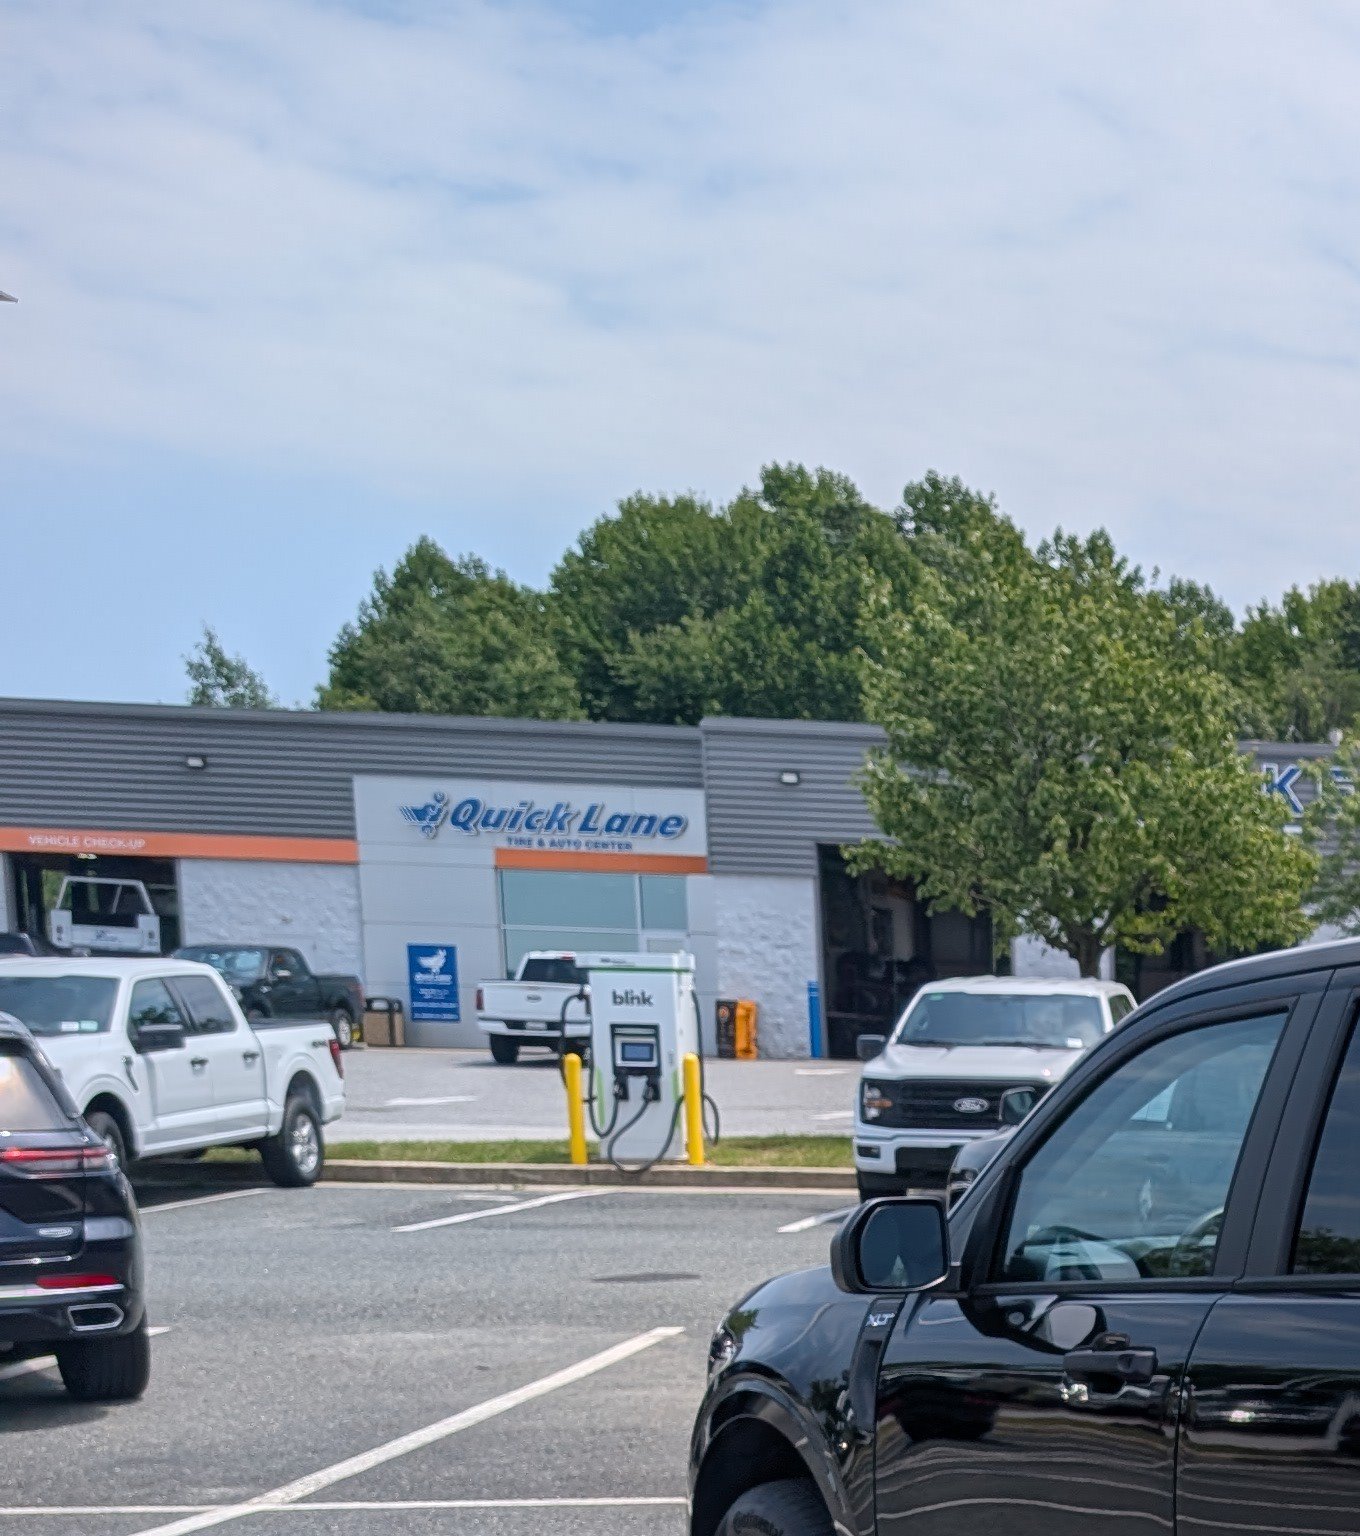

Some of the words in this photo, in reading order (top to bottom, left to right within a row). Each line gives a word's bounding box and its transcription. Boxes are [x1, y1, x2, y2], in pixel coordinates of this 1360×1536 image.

[450, 797, 574, 836] Quick
[577, 800, 688, 838] Lane
[28, 835, 79, 848] VEHICLE
[506, 835, 532, 847] TIRE
[549, 838, 582, 850] AUTO
[584, 839, 634, 851] CENTER
[612, 989, 654, 1006] blink
[865, 1313, 895, 1327] XLT
